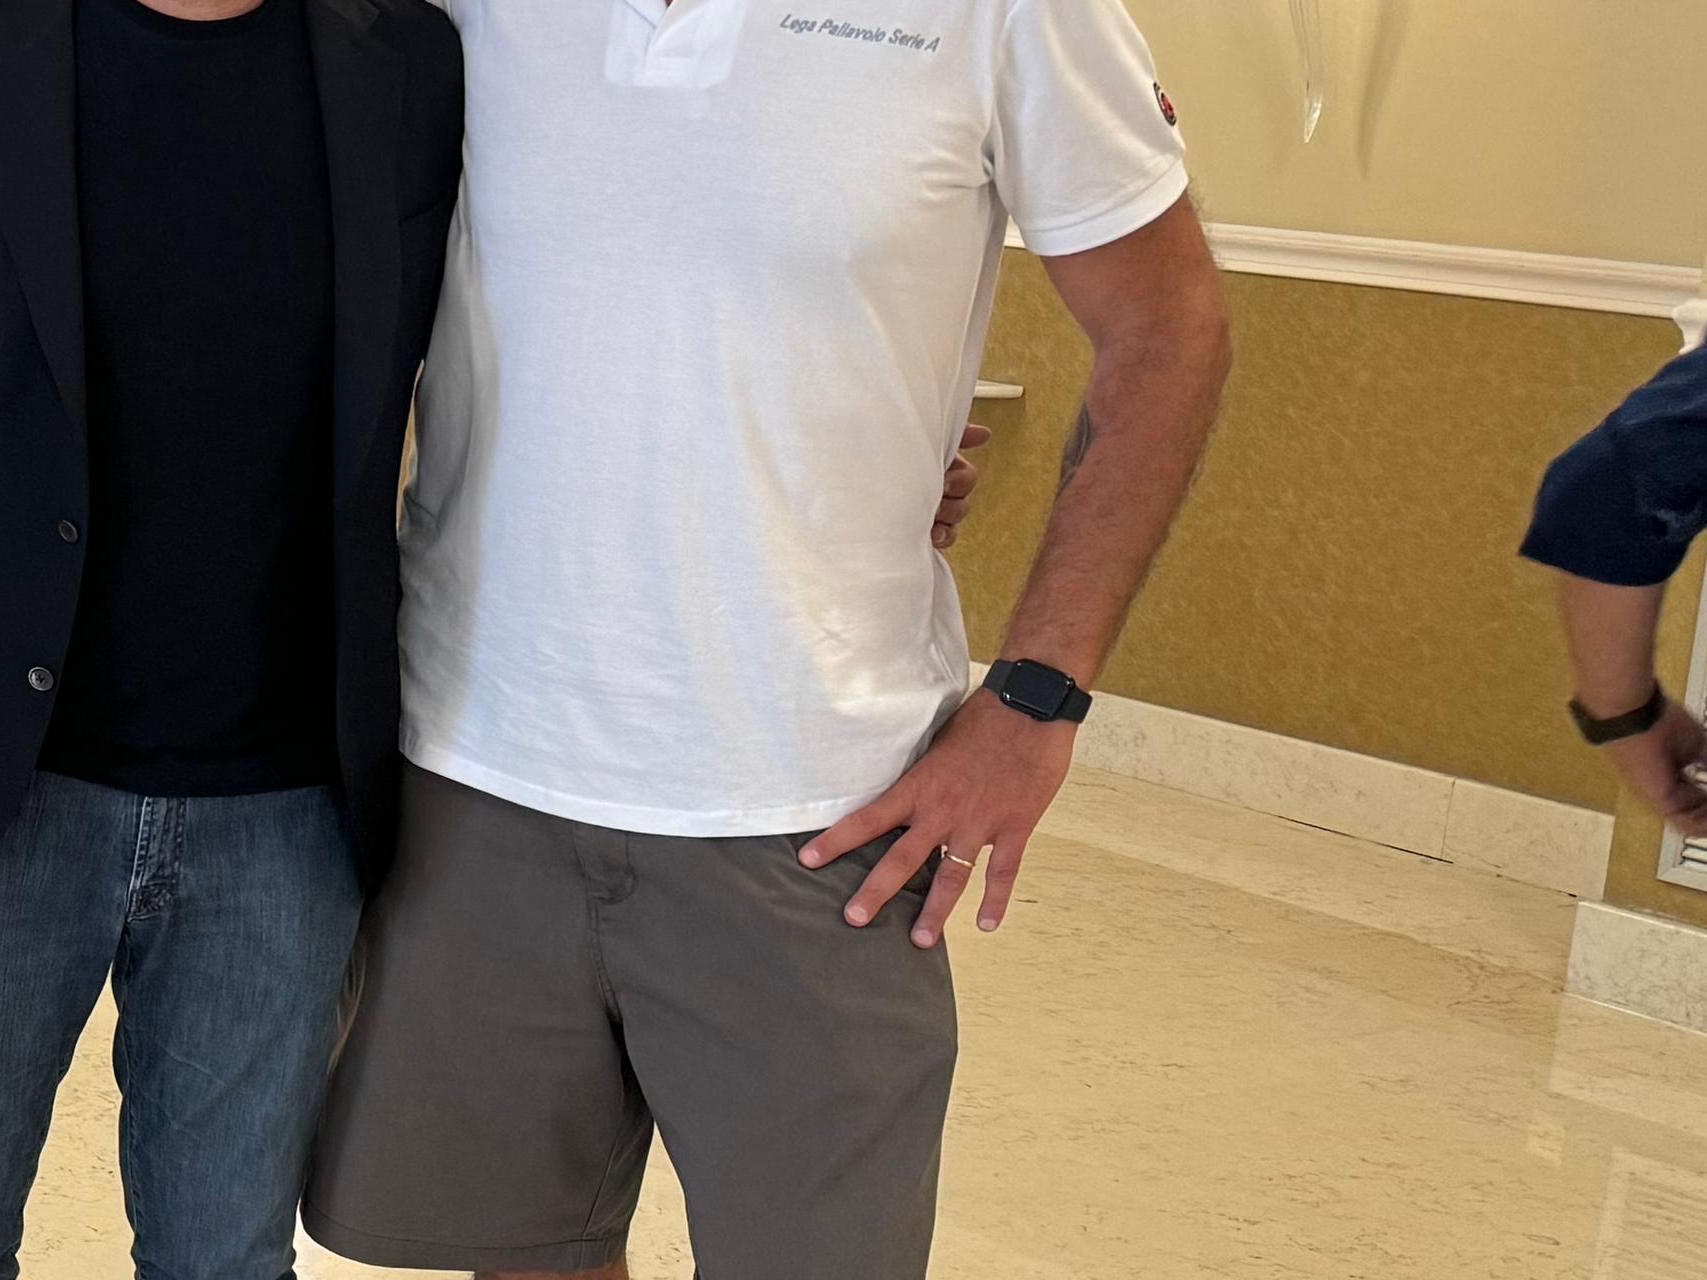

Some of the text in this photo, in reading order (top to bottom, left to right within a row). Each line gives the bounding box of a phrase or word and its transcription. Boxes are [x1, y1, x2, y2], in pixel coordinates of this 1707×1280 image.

[779, 13, 941, 53] Lega Pallavolo Serie A
